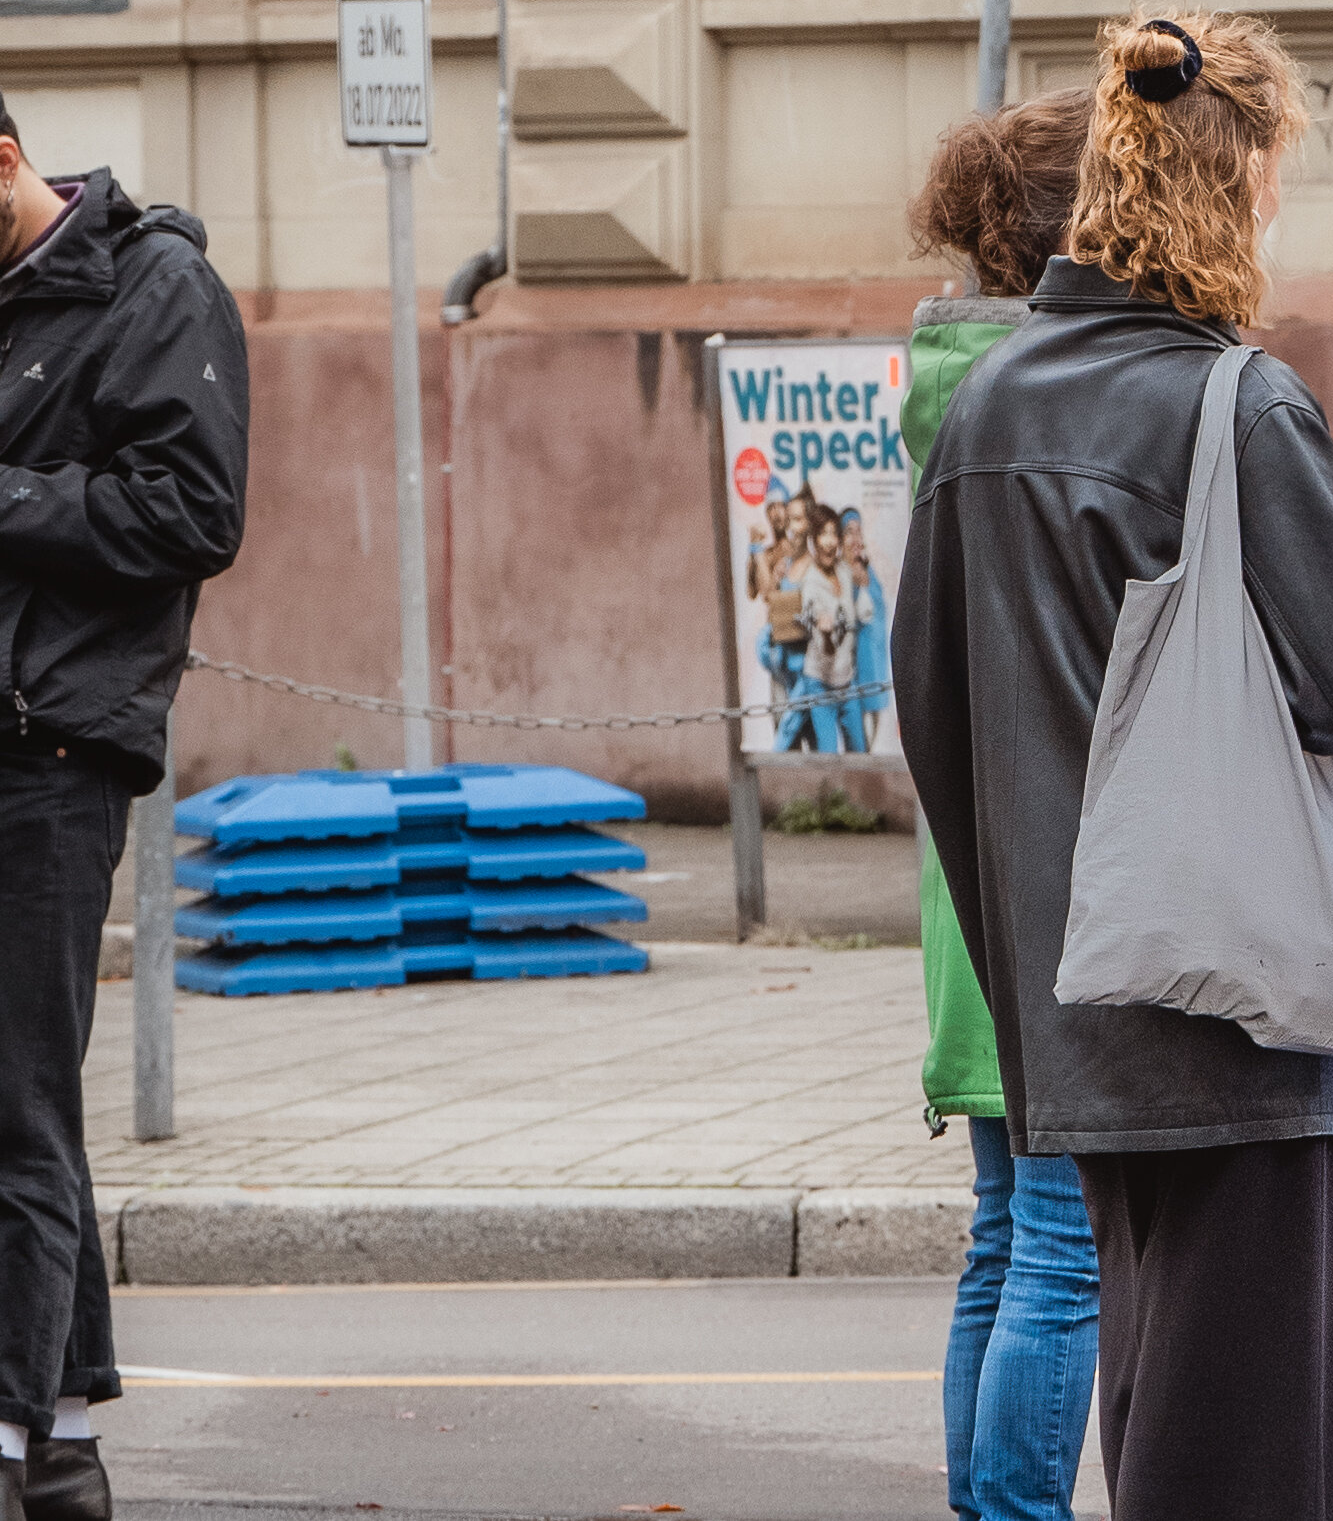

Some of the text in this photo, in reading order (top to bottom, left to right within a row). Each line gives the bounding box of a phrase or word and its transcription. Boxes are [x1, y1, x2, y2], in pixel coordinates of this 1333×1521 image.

[359, 15, 375, 56] ab
[348, 84, 422, 126] 18.07.2022
[729, 365, 880, 422] Winter
[772, 414, 904, 481] speck
